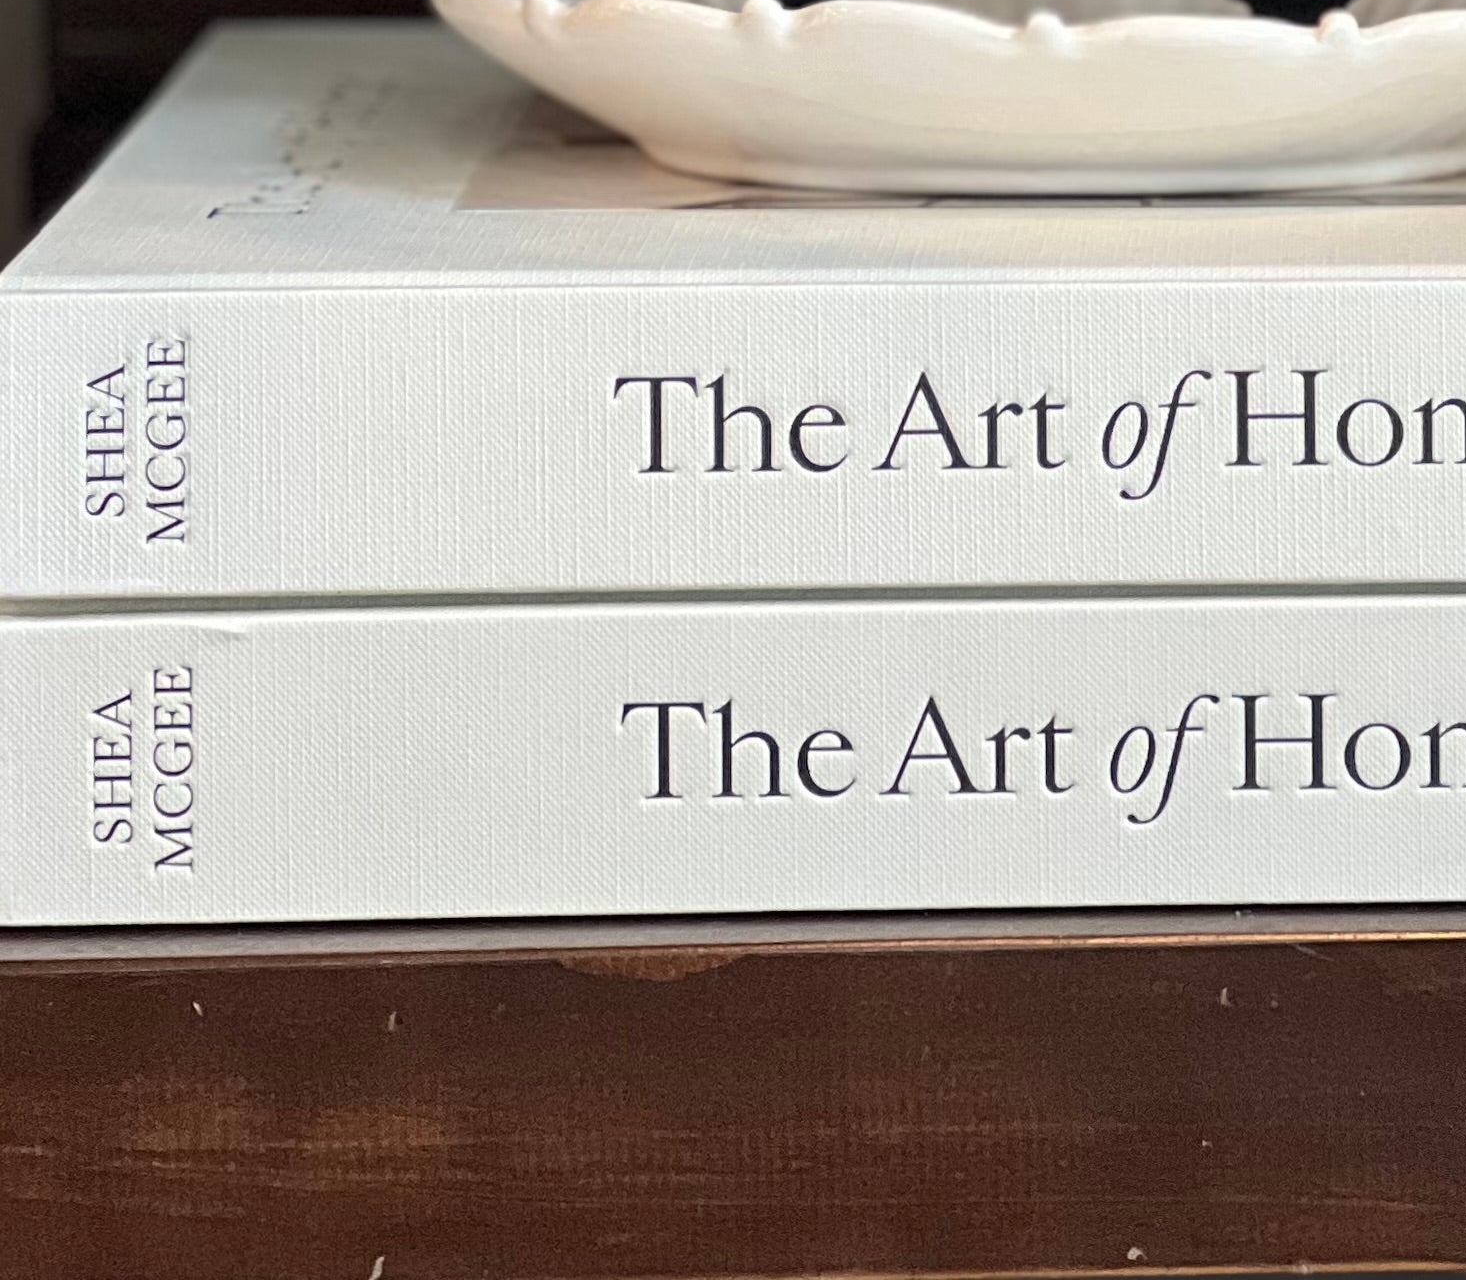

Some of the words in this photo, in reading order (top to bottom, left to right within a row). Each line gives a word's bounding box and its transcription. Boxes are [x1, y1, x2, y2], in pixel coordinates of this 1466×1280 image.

[85, 365, 125, 517] SHEA
[145, 340, 186, 543] MCGEE
[613, 374, 847, 473] The
[871, 371, 1066, 471] Art
[1101, 369, 1213, 501] of
[92, 690, 133, 843] SHEA
[153, 666, 194, 868] MCGEE
[621, 698, 856, 799] The
[879, 696, 1074, 795] Art
[1109, 693, 1220, 824] of
